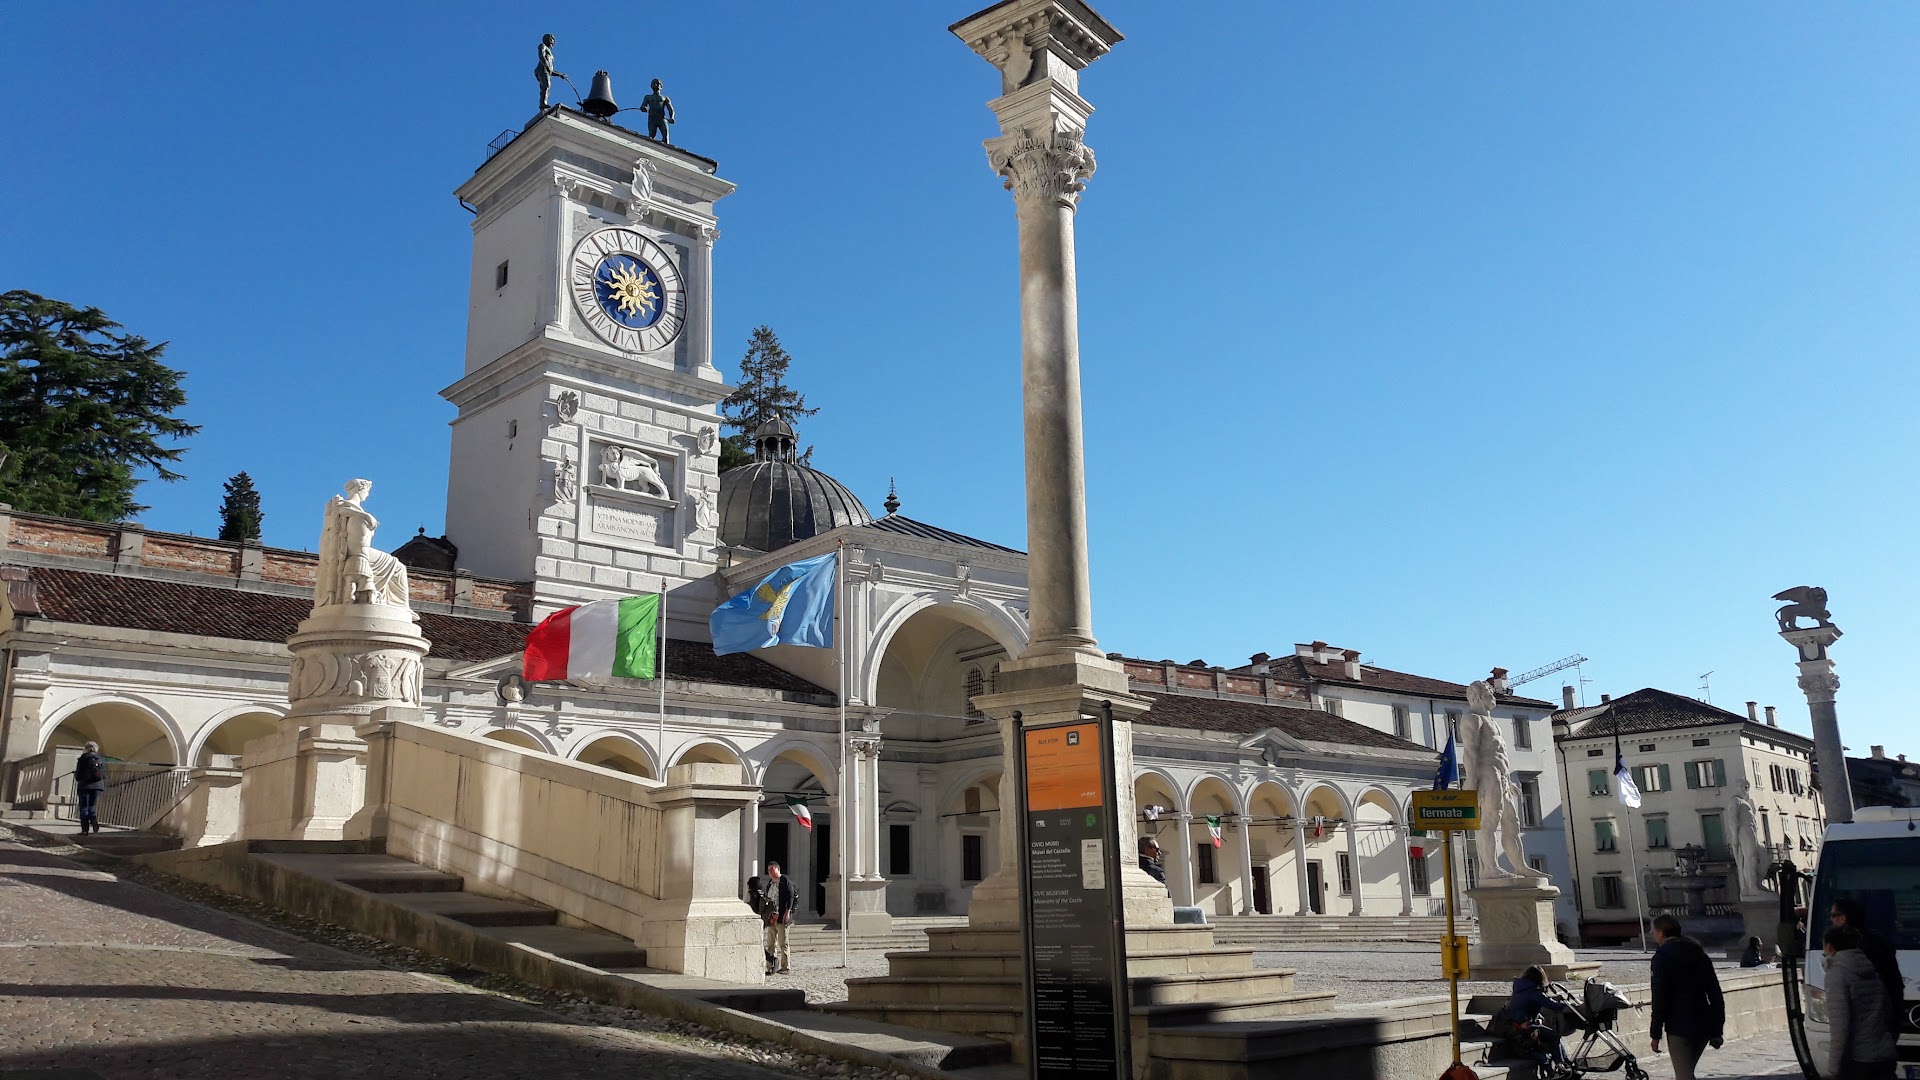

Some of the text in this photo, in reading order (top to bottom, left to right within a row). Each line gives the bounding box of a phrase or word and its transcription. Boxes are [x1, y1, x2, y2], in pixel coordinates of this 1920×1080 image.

[598, 232, 618, 250] XI
[623, 232, 642, 252] XII
[581, 244, 599, 263] X
[664, 275, 678, 284] II
[578, 292, 596, 315] VIII
[669, 297, 684, 311] III
[594, 315, 613, 340] VII
[661, 316, 679, 336] IIII
[621, 330, 638, 349] VI
[649, 333, 662, 349] V
[1422, 808, 1463, 818] fermata
